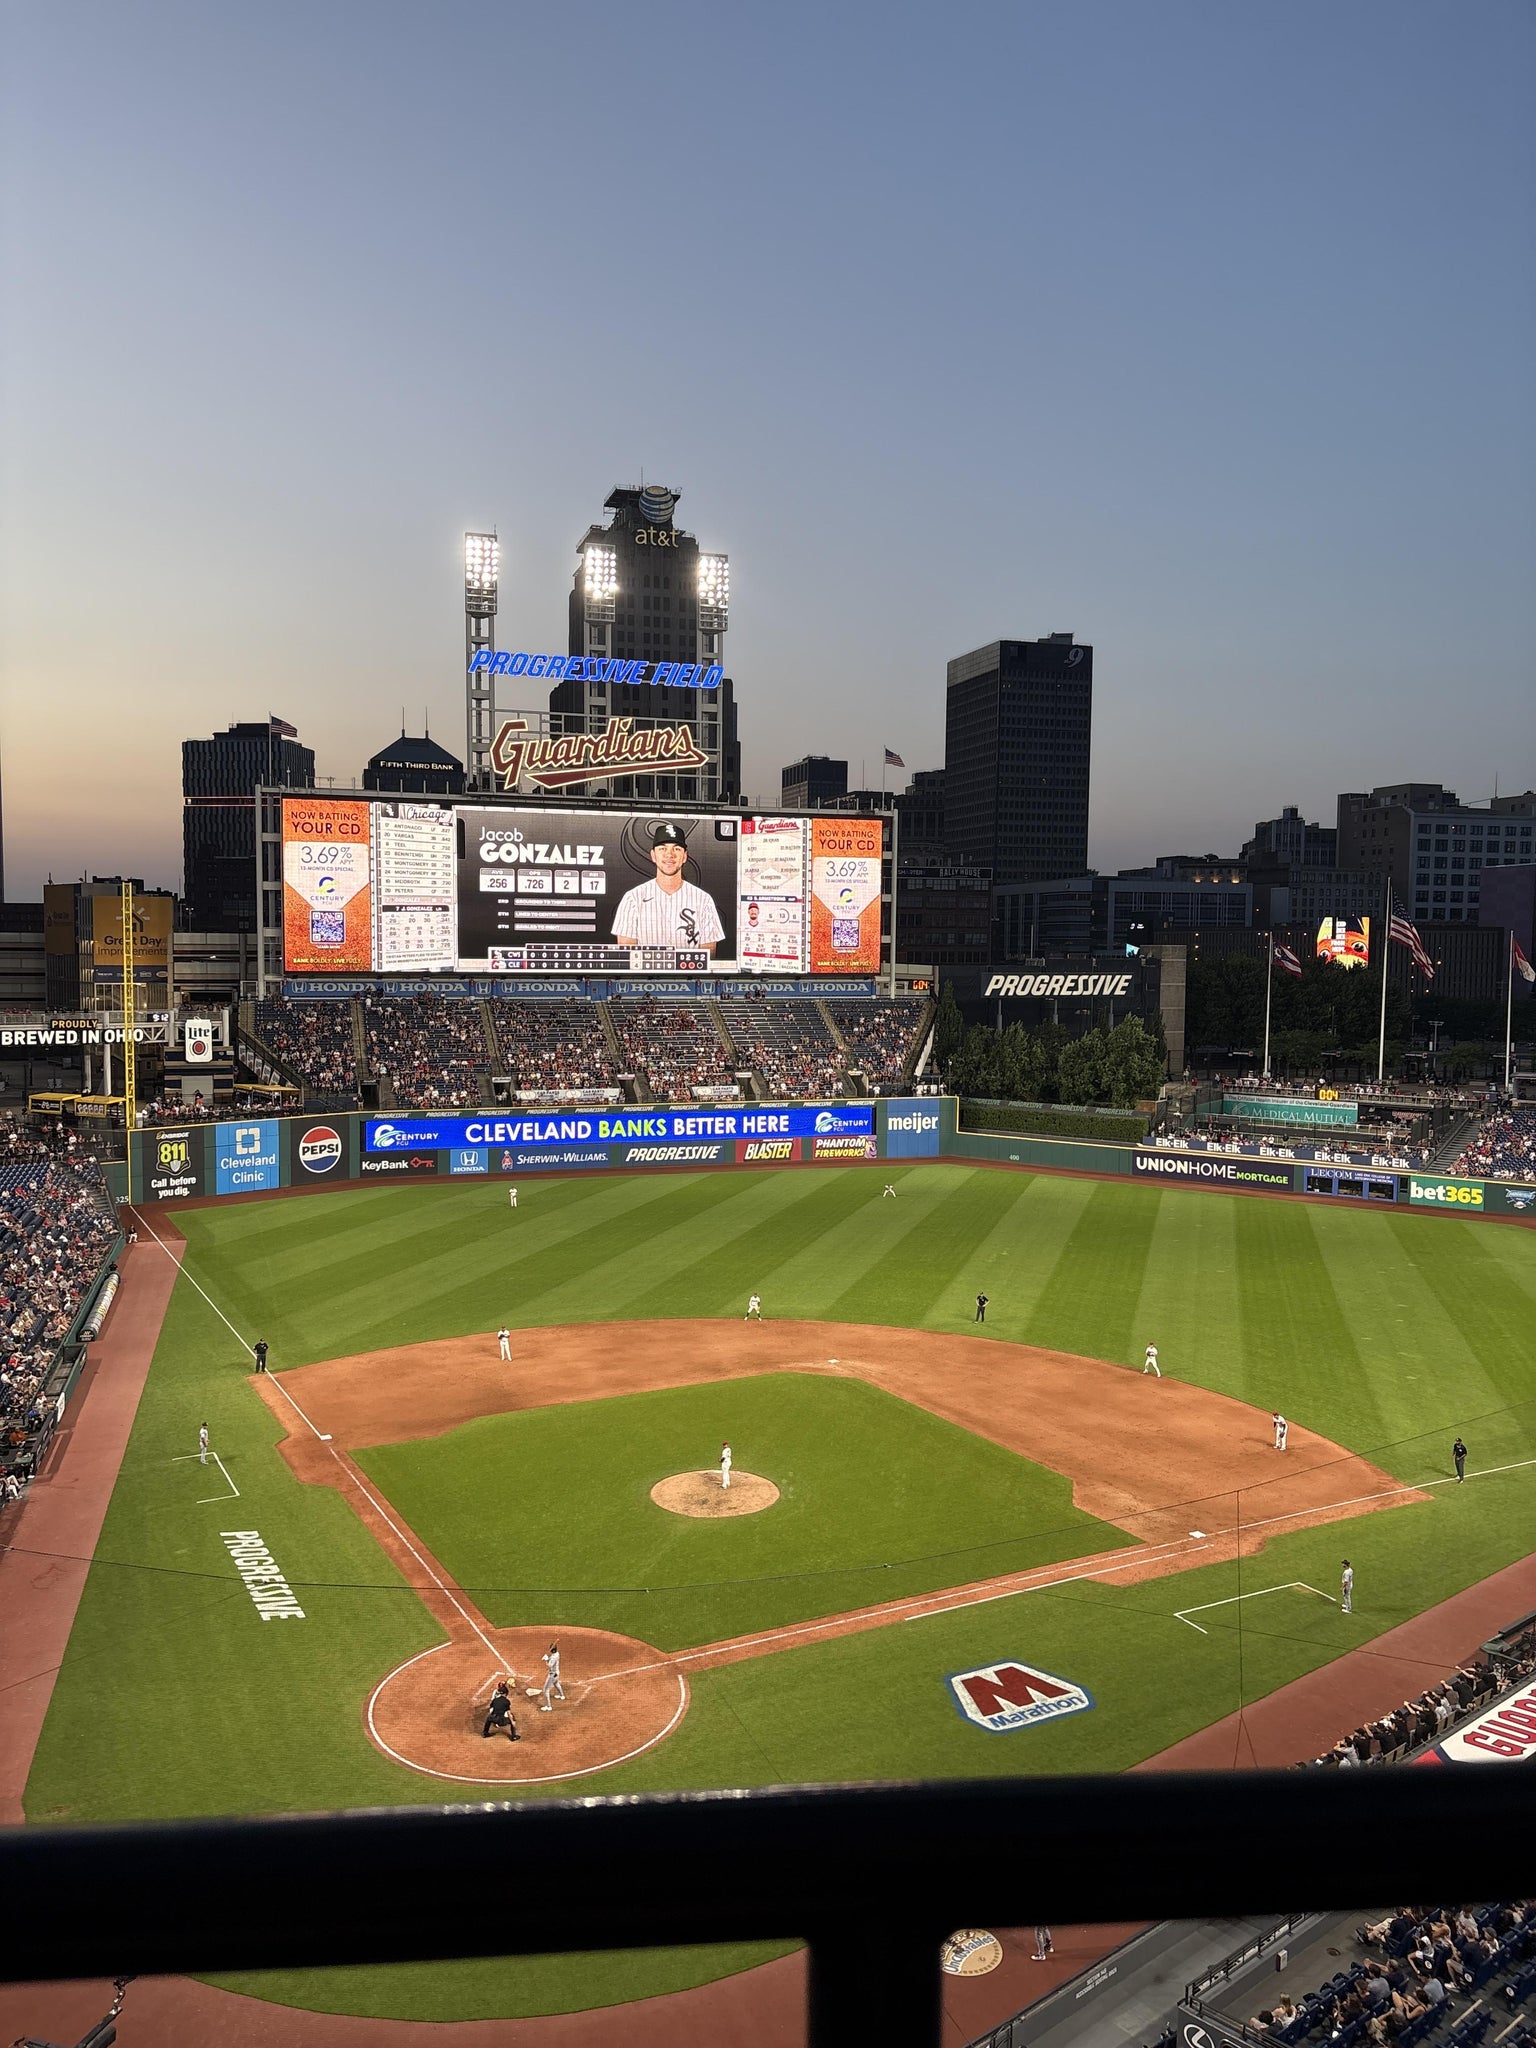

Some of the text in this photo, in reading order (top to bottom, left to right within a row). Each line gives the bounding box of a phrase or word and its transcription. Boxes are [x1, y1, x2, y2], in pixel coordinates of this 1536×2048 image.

[635, 526, 679, 548] at&t
[468, 650, 725, 689] PROGRESSIVE FIELD
[490, 717, 709, 790] Guardians
[291, 812, 316, 820] NOW
[407, 807, 447, 823] Chicago
[292, 822, 360, 834] YOUR CD
[724, 826, 729, 834] 7
[758, 818, 800, 833] Guardians
[479, 826, 523, 842] Jacob
[820, 840, 875, 850] YOUR CD
[480, 842, 604, 865] GONZALEZ
[488, 878, 599, 890] .256 .726 2 17
[104, 936, 162, 947] Gret Day
[98, 947, 168, 956] Improements
[309, 982, 376, 992] HONDA
[400, 983, 467, 992] HONDA
[517, 984, 581, 992] HONDA
[630, 982, 691, 992] HONDA
[737, 982, 795, 992] HONDA
[812, 982, 870, 992] HONDA
[984, 974, 1132, 996] PROGRESSIVE
[152, 1014, 169, 1022] 9:12
[52, 1020, 98, 1029] PROUDLY
[2, 1028, 144, 1046] BREWED IN OHIO
[188, 1027, 211, 1040] Lite
[1320, 1090, 1338, 1100] 0:04
[1008, 1100, 1044, 1109] PROGRESSIVE
[1095, 1107, 1133, 1116] PROGRESSIVE
[1252, 1108, 1300, 1120] MEDICAL
[466, 1115, 790, 1142] CLEVELAND BANKS BETTER HERE
[832, 1120, 869, 1128] CENTURY
[888, 1113, 939, 1134] meijer
[396, 1132, 439, 1141] CENTURY
[816, 1138, 866, 1148] PHANTOM
[160, 1143, 186, 1163] 811
[302, 1143, 339, 1156] PEPSI
[626, 1145, 722, 1162] PROGRESSIVE
[745, 1142, 793, 1160] BLASTER
[815, 1148, 866, 1158] FIREWORKS
[220, 1155, 276, 1170] Cleveland
[362, 1160, 409, 1171] KeyBank
[152, 1176, 196, 1188] Call before
[232, 1172, 264, 1184] Clinic
[1237, 1172, 1289, 1184] MORTGAGE
[158, 1187, 190, 1199] you dig.
[1410, 1182, 1483, 1205] bet365
[220, 1530, 306, 1621] PROGRESSIVE
[988, 1696, 1084, 1728] Marathon
